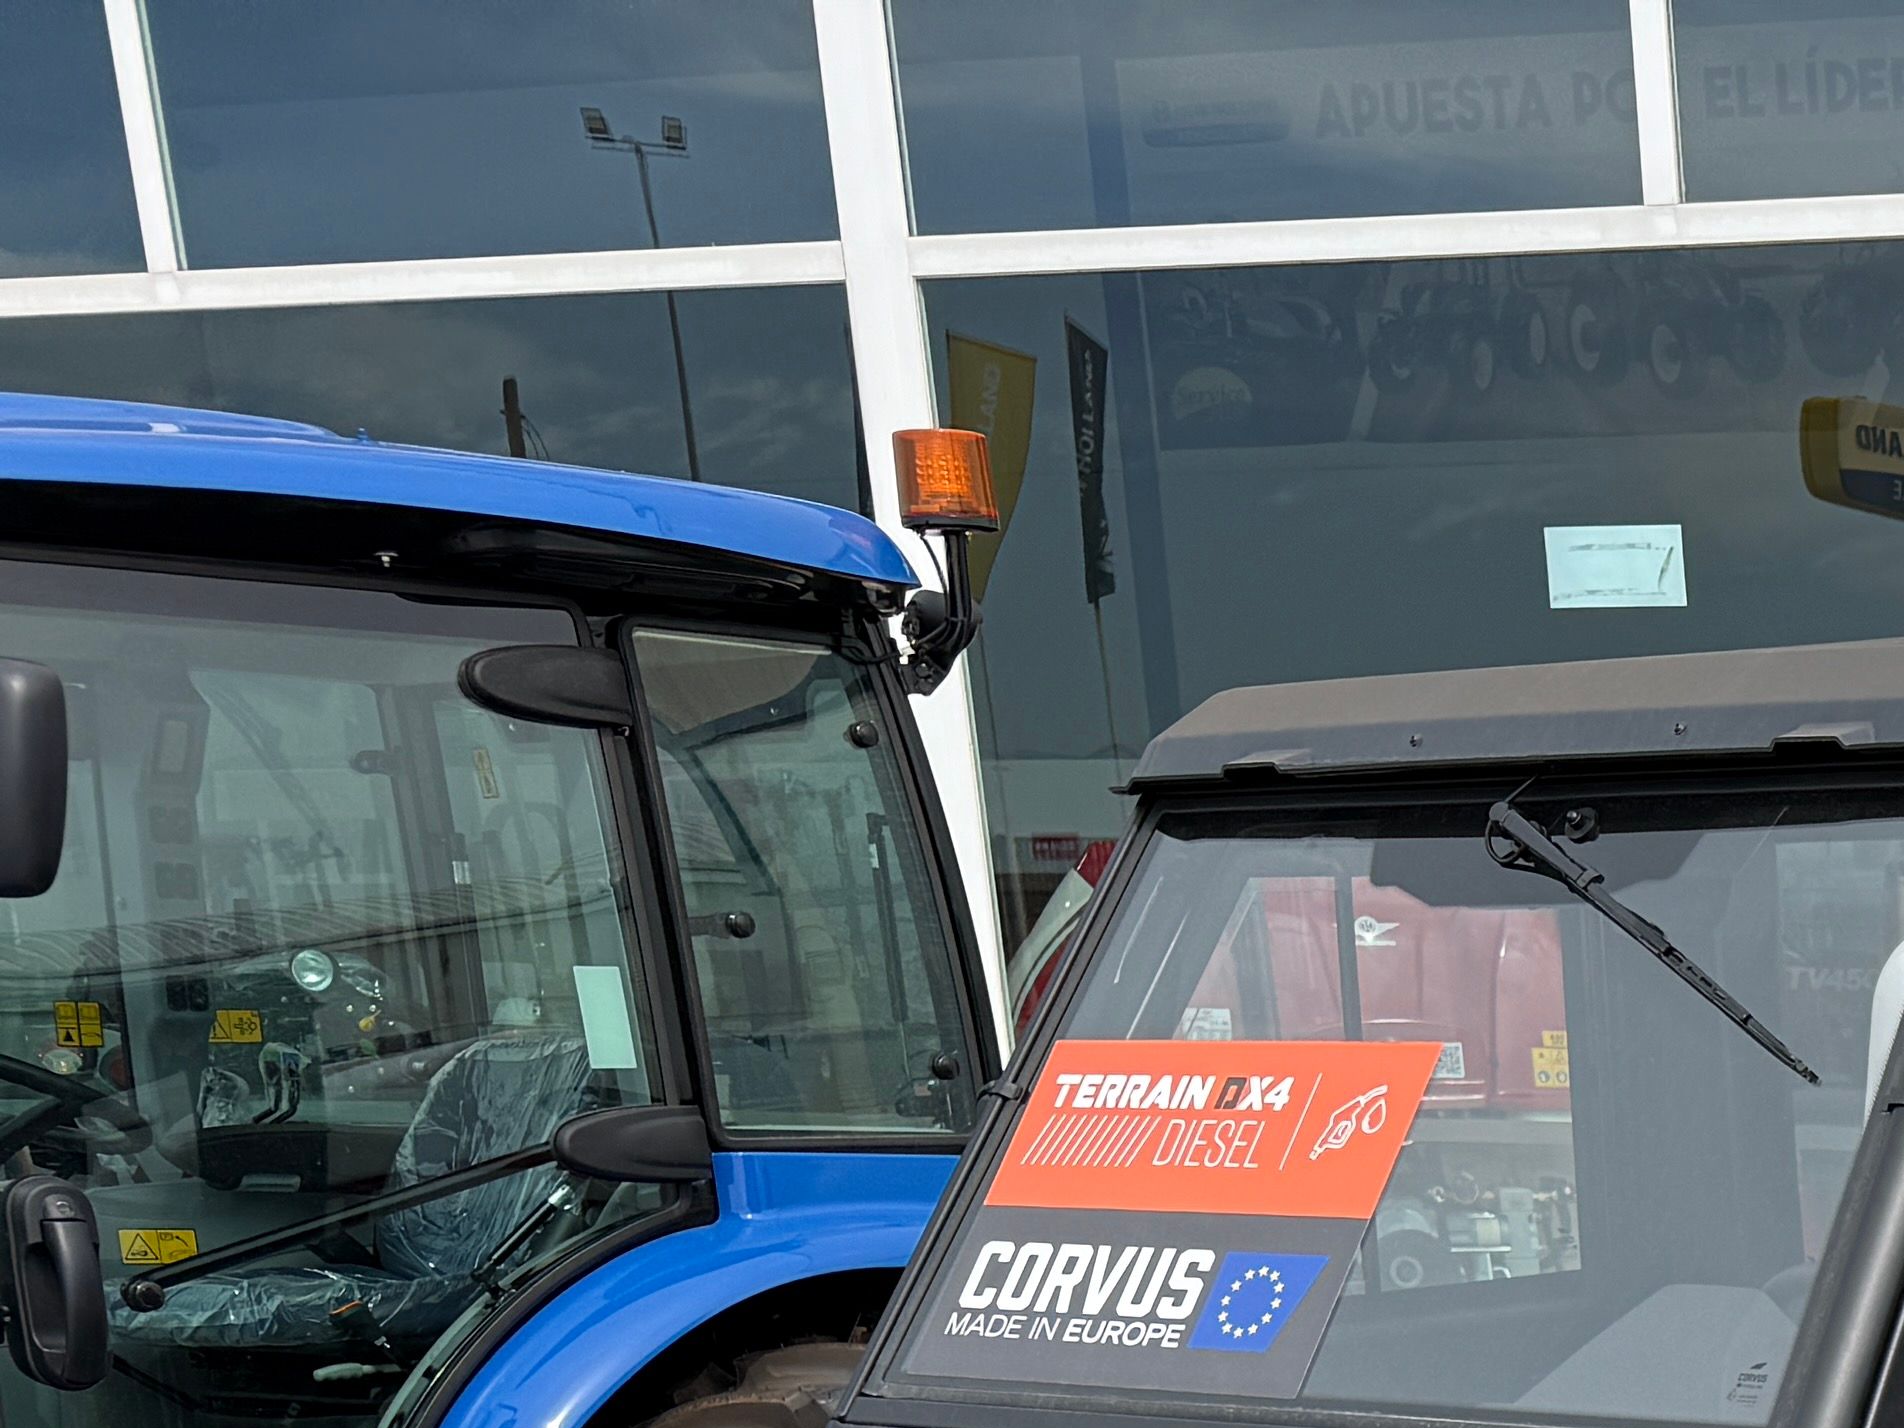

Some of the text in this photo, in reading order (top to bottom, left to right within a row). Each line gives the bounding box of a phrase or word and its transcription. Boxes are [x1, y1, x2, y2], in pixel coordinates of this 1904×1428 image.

[1315, 73, 1552, 138] APUESTA
[1572, 68, 1637, 126] PO
[1703, 65, 1765, 118] EL
[1055, 1074, 1216, 1110] TERRAIN
[1152, 1118, 1266, 1169] DIESEL
[957, 1240, 1216, 1320] CORVUS
[944, 1312, 1187, 1349] MADE IN EUROPE
